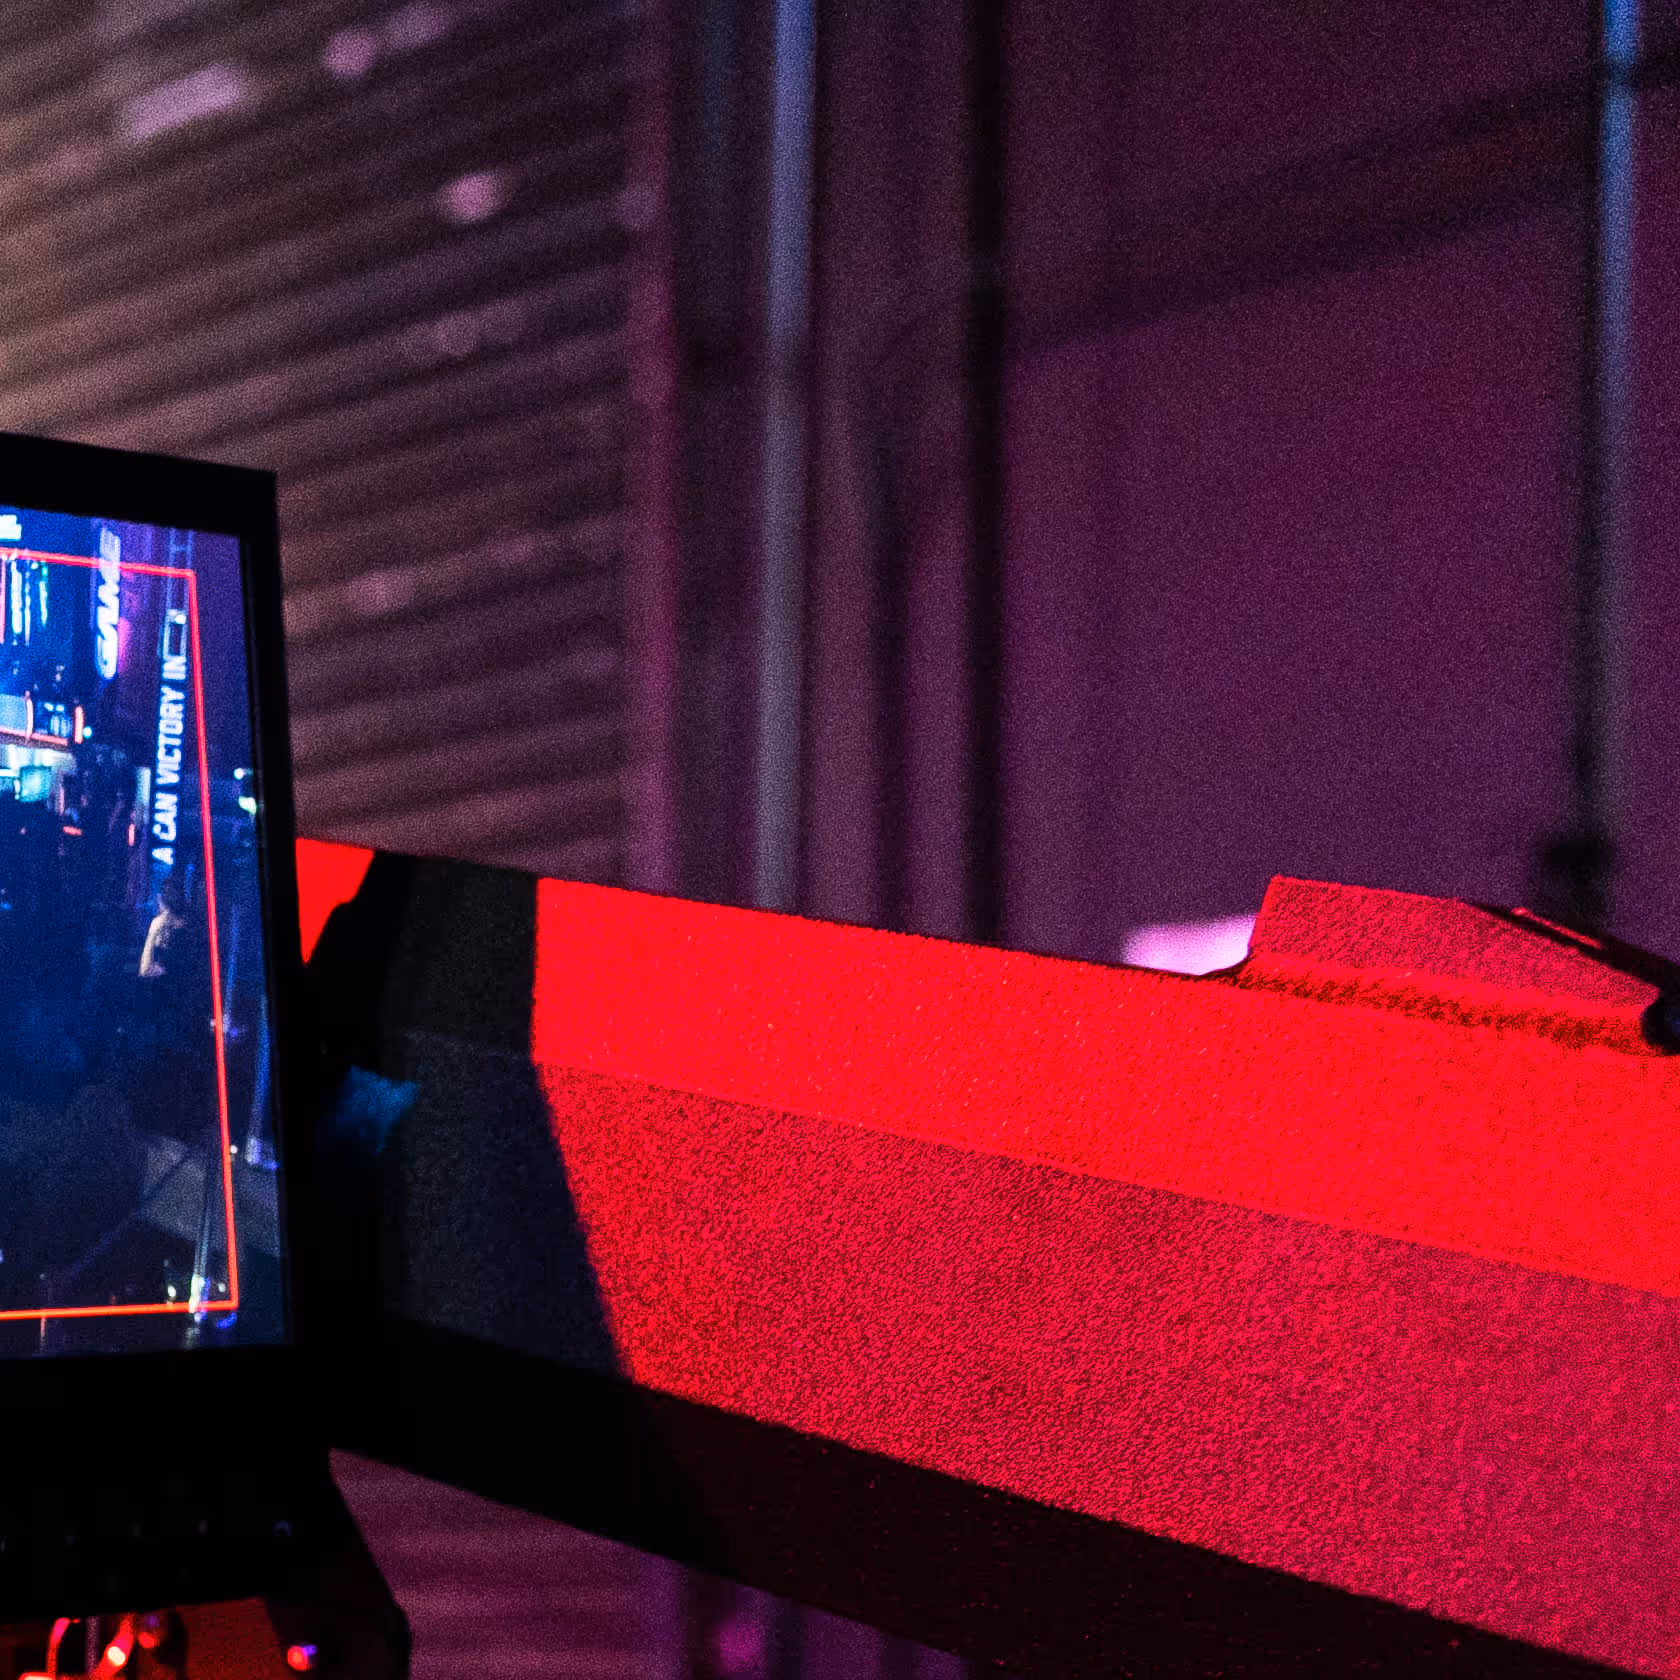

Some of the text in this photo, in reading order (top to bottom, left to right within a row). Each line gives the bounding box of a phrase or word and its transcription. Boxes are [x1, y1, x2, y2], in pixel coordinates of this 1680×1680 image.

[152, 654, 187, 865] A CAN VICTORY IN
